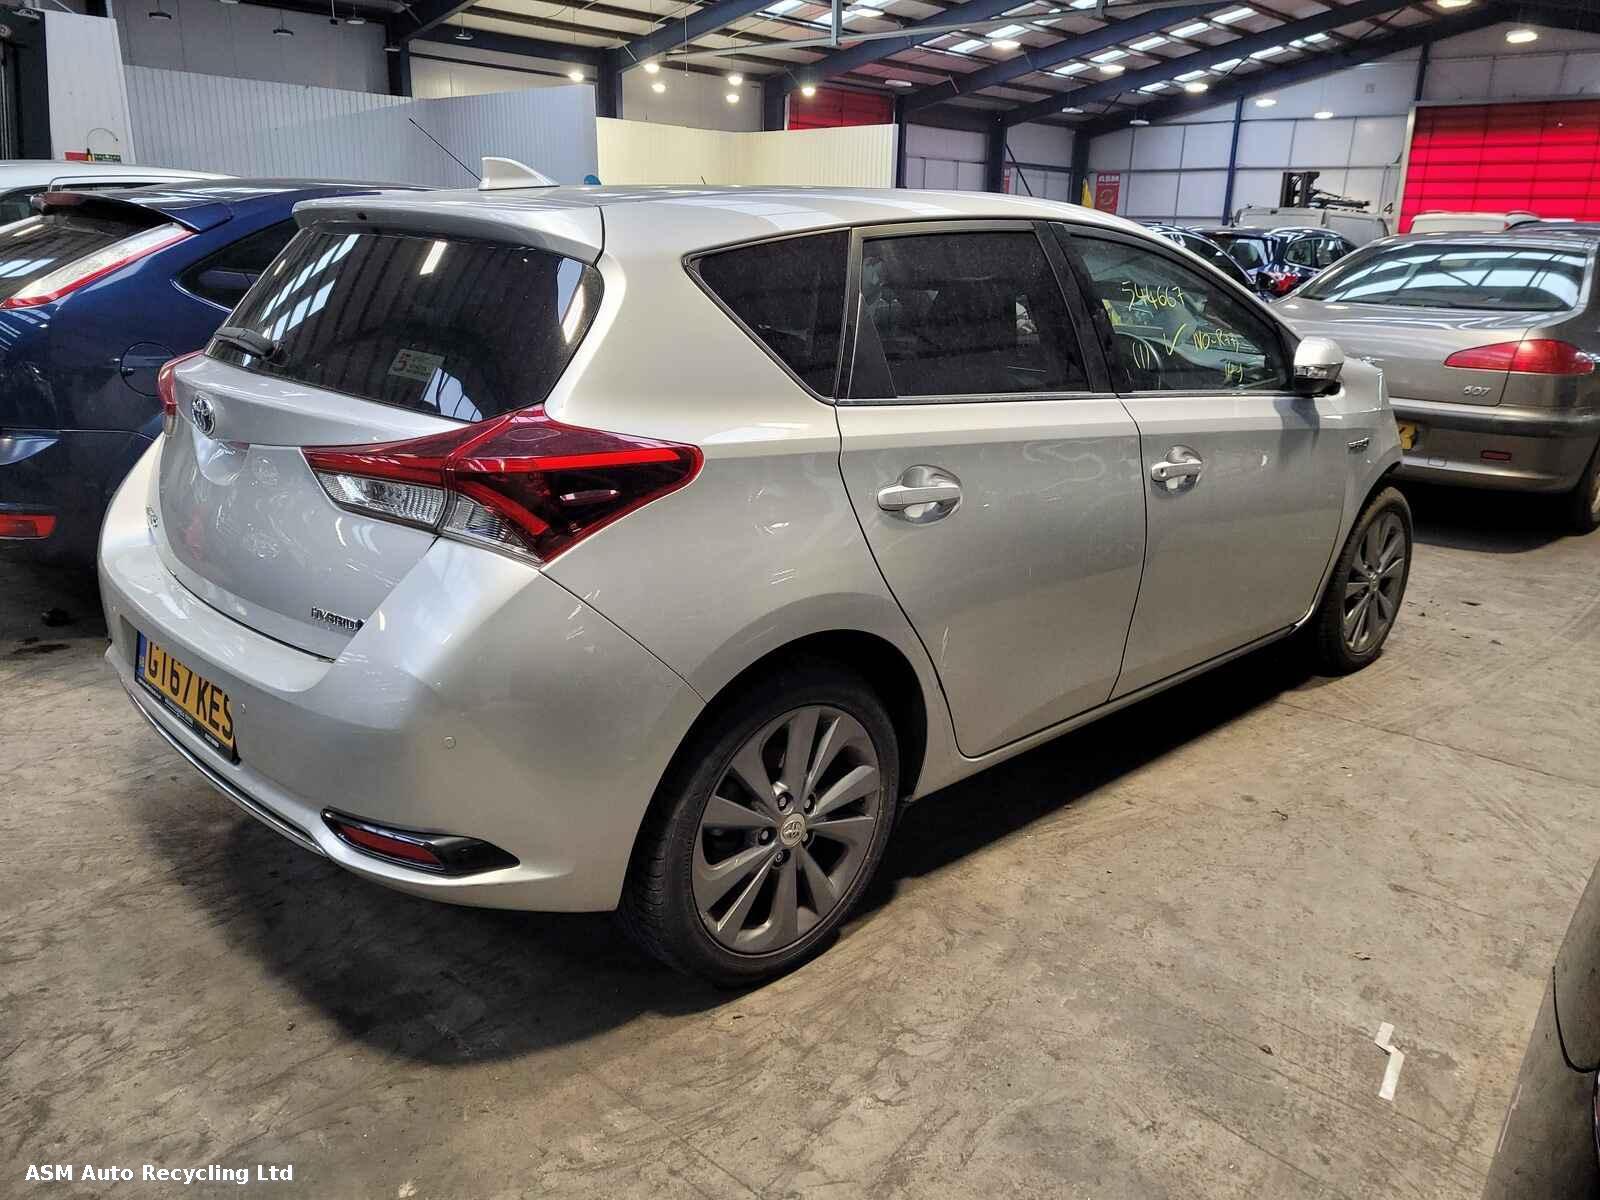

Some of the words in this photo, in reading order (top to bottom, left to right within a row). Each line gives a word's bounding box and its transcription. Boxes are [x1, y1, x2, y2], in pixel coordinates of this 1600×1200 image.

[1383, 202, 1393, 215] 4
[311, 606, 356, 631] HYBRID
[148, 641, 193, 704] GT67
[195, 673, 234, 741] KES
